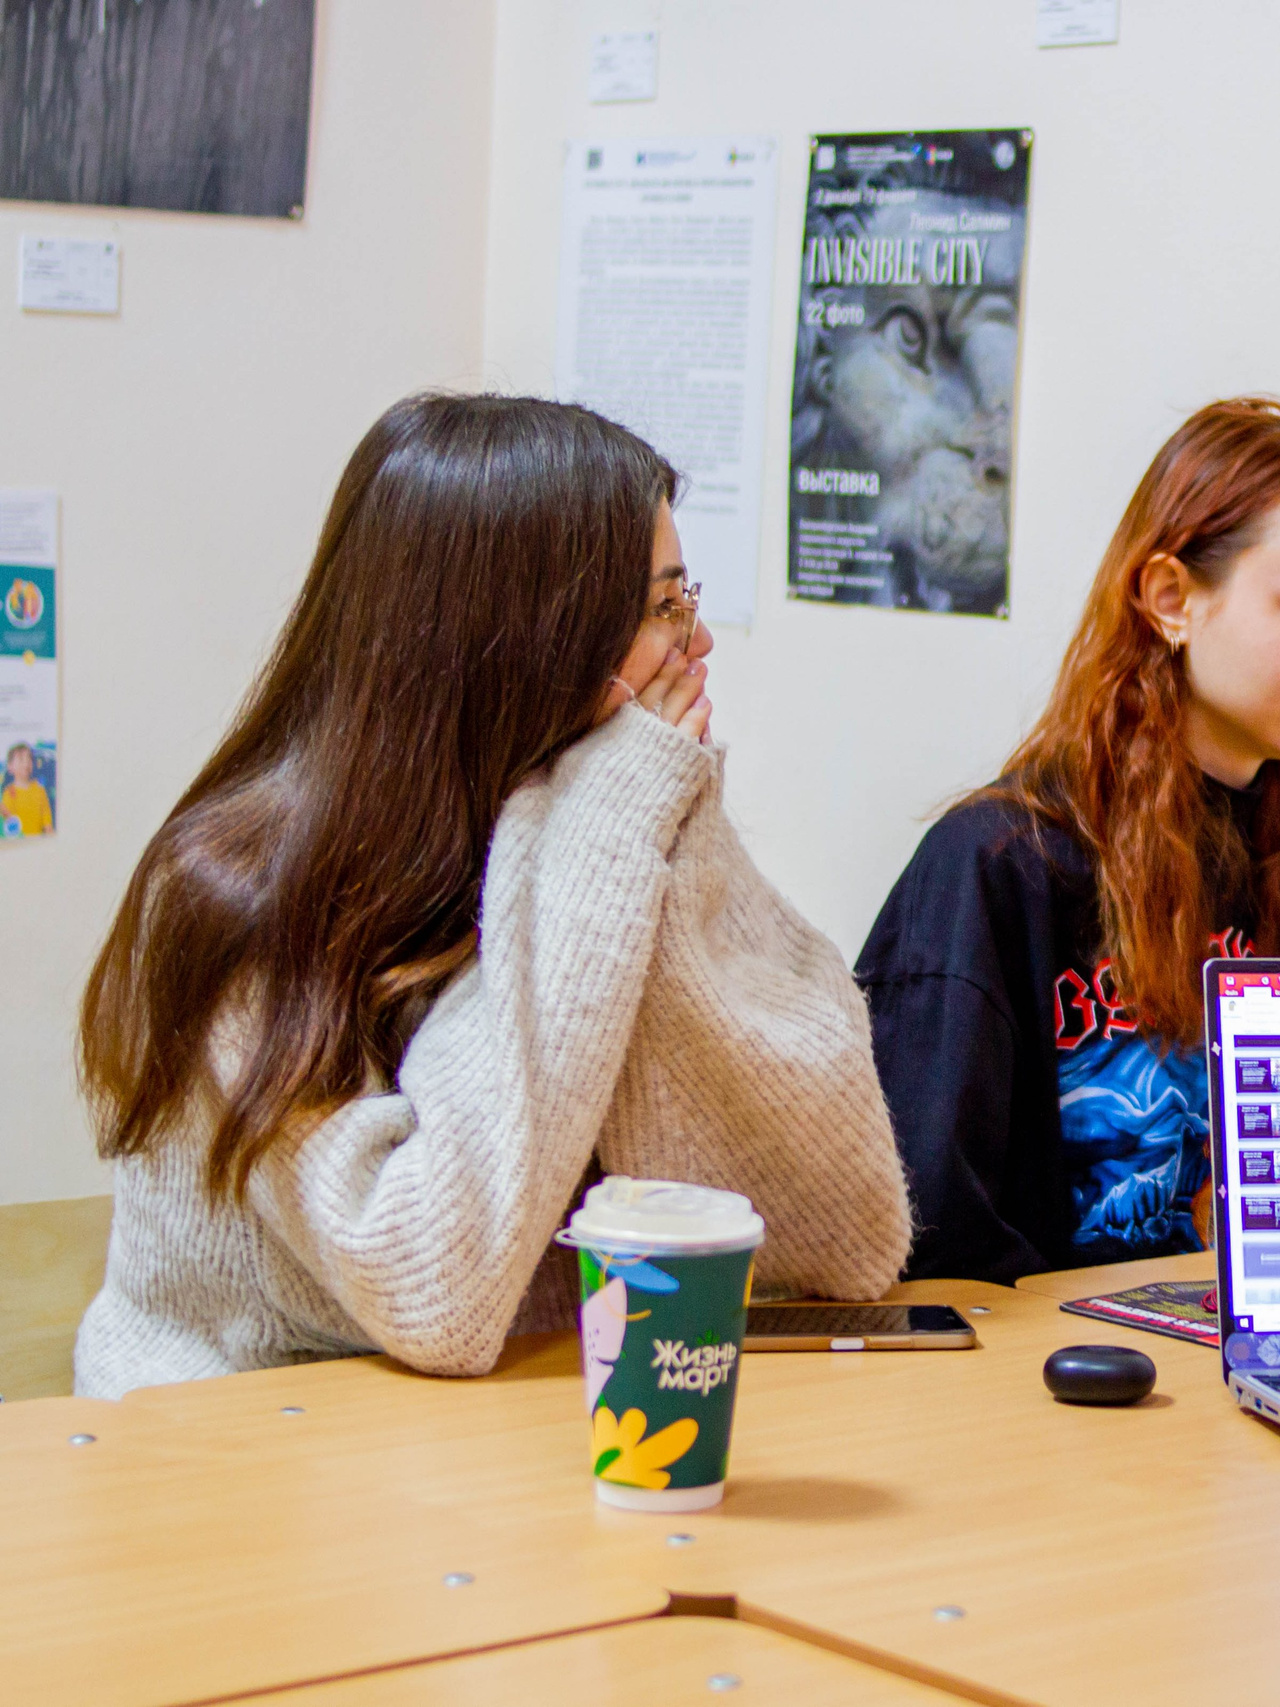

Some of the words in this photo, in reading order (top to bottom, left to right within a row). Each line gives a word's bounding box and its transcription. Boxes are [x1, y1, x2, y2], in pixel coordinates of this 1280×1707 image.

[806, 236, 922, 285] INVISIBLE
[931, 237, 989, 285] CITY
[805, 303, 823, 325] 22
[826, 304, 865, 328] фото
[650, 1339, 737, 1369] Жизнь
[658, 1364, 733, 1396] март
